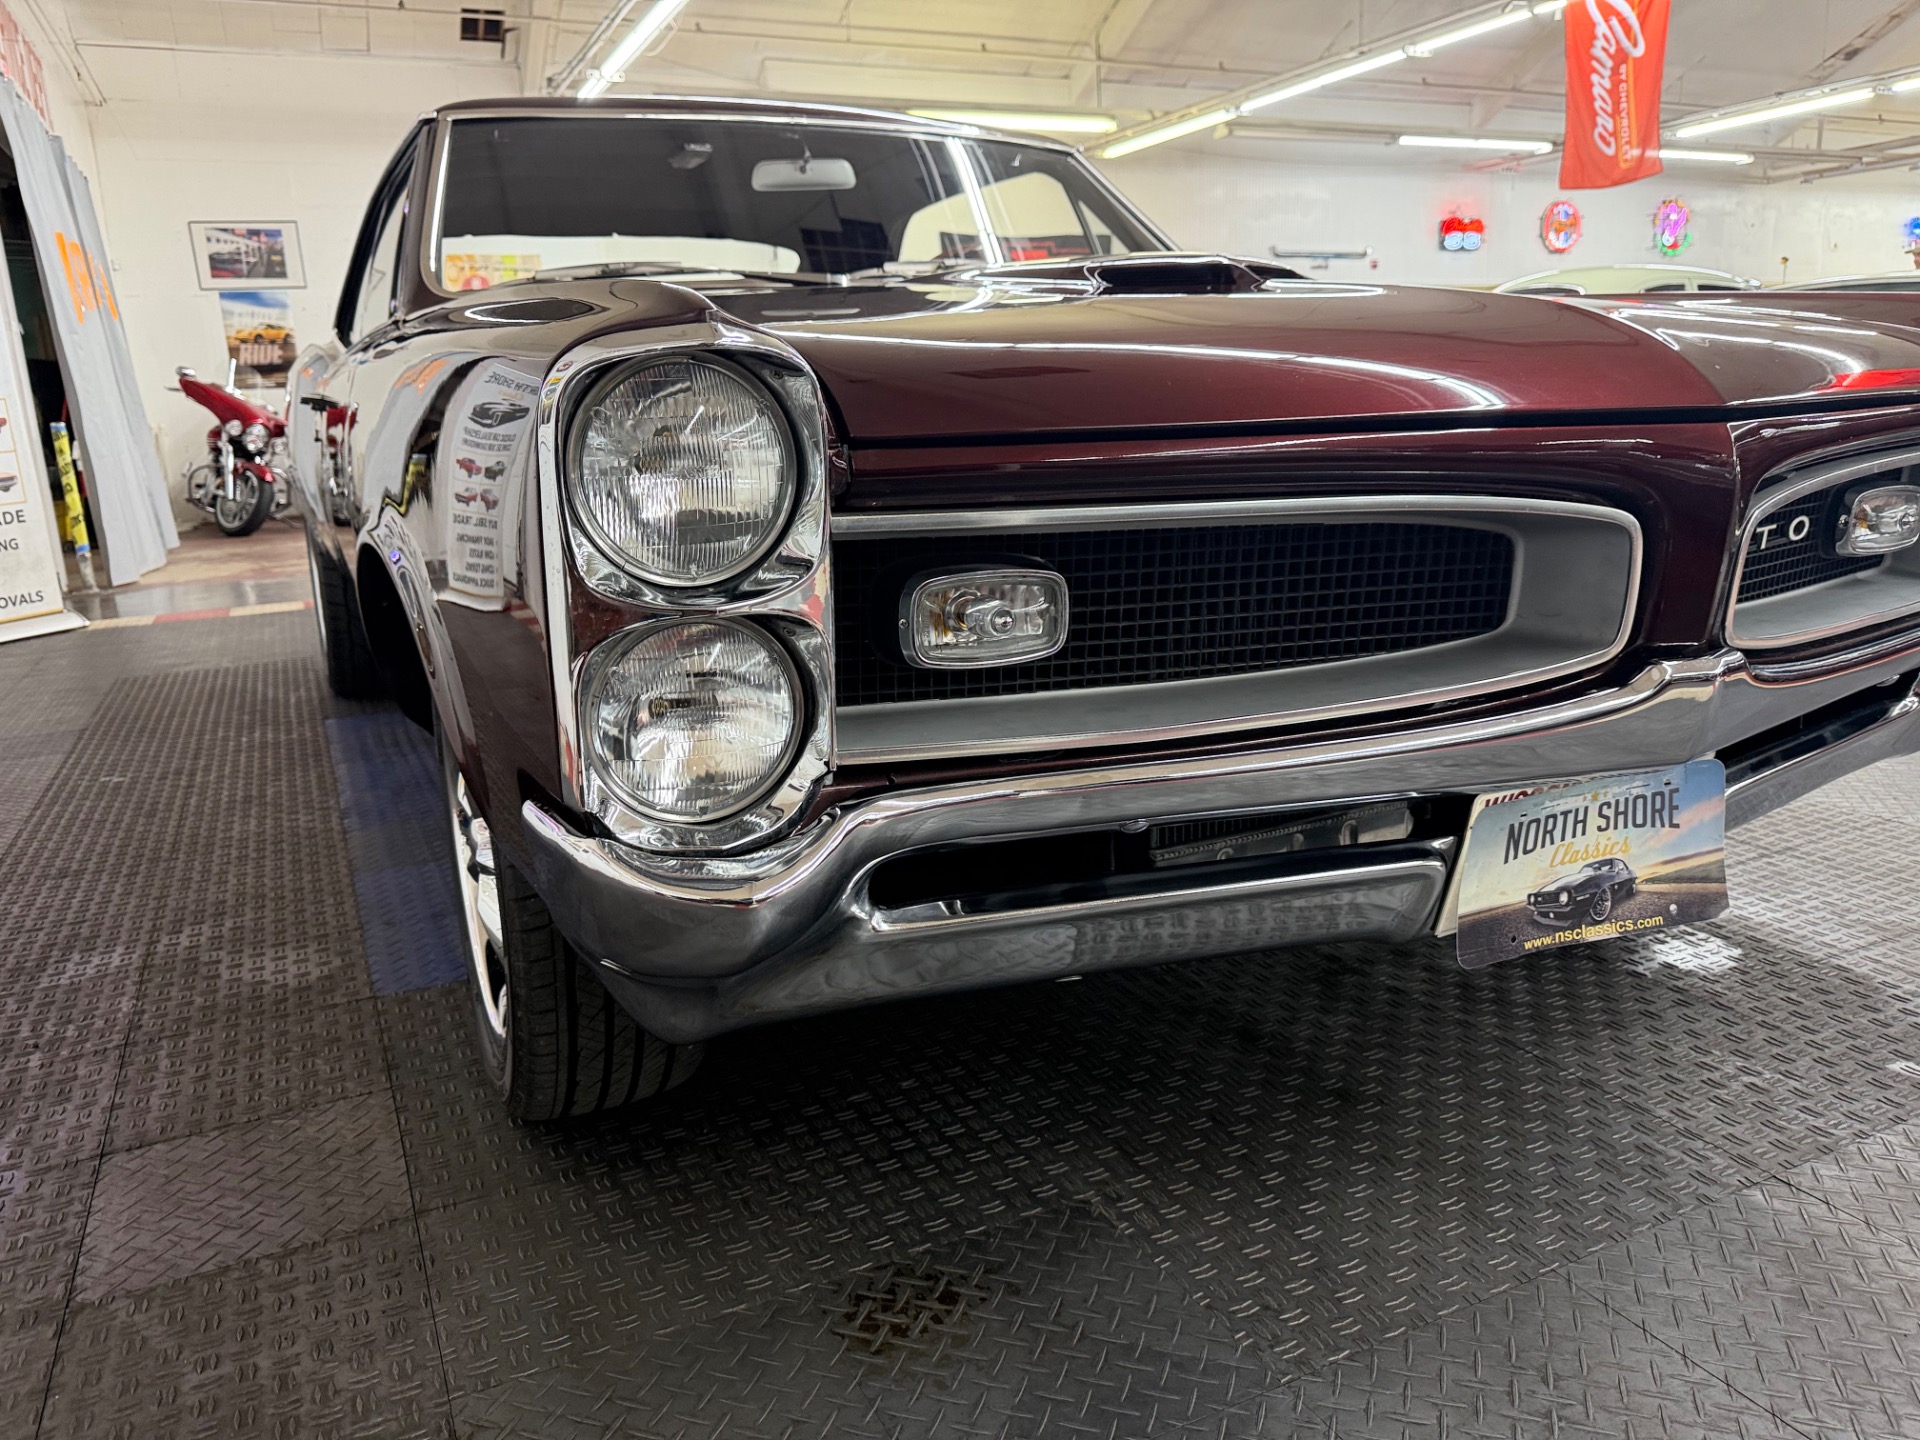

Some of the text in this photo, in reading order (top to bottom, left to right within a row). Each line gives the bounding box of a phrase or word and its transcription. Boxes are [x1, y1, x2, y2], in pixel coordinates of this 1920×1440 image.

[1585, 0, 1646, 157] Camaro
[1618, 82, 1633, 161] CHEVROLET
[239, 342, 284, 366] RIDE
[0, 508, 27, 526] DE
[1503, 805, 1588, 865] NORTH
[1596, 787, 1681, 832] SHORE
[1549, 836, 1632, 868] Classics
[1524, 914, 1664, 951] www.nsclassics.com
